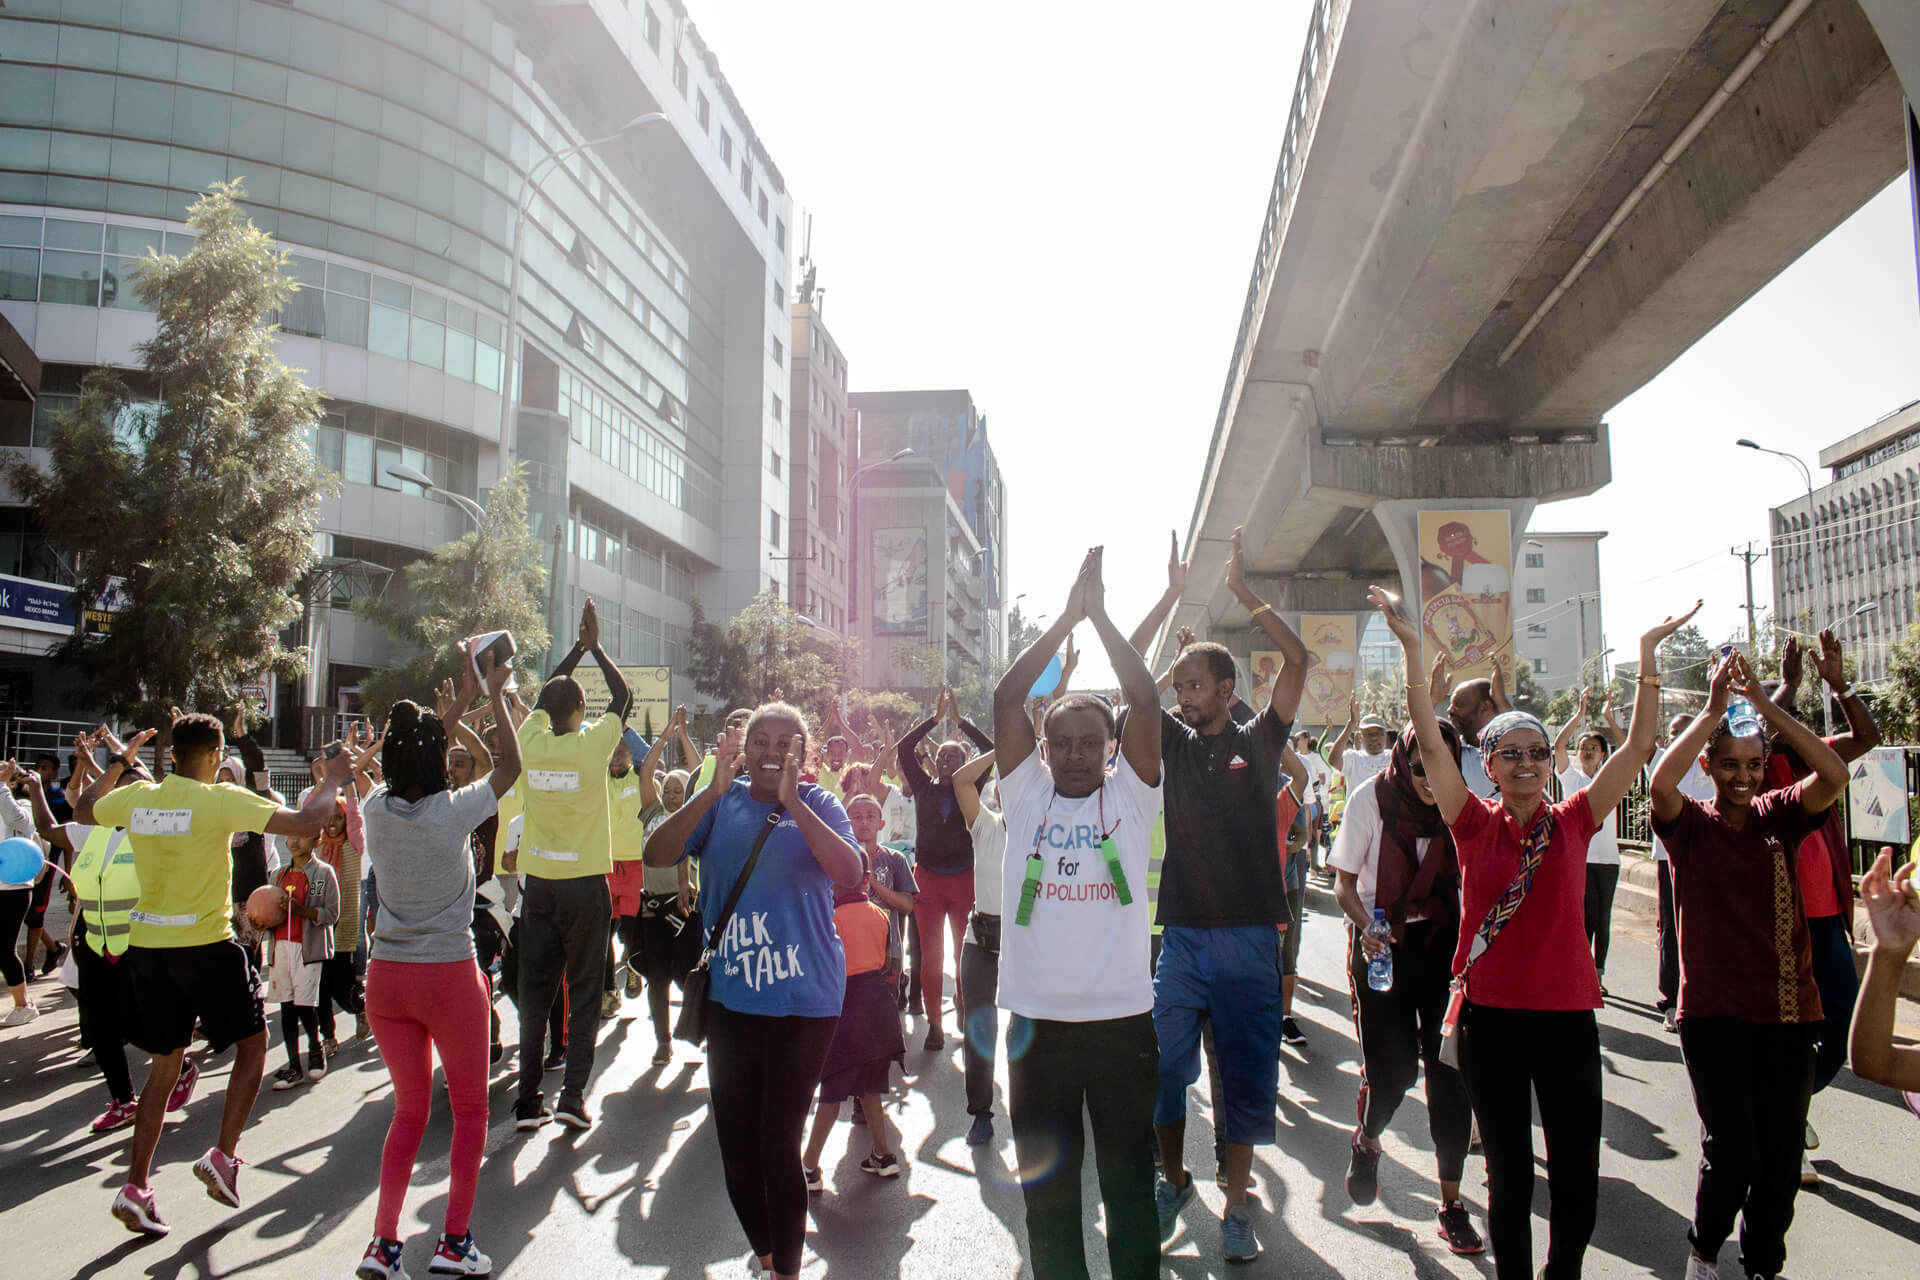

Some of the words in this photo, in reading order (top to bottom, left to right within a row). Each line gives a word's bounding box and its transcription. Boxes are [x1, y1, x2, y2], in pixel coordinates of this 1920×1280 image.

[42, 608, 59, 616] BRANCH
[1058, 856, 1080, 876] for
[310, 880, 326, 896] 87
[724, 960, 739, 976] the
[736, 944, 804, 992] TALK
